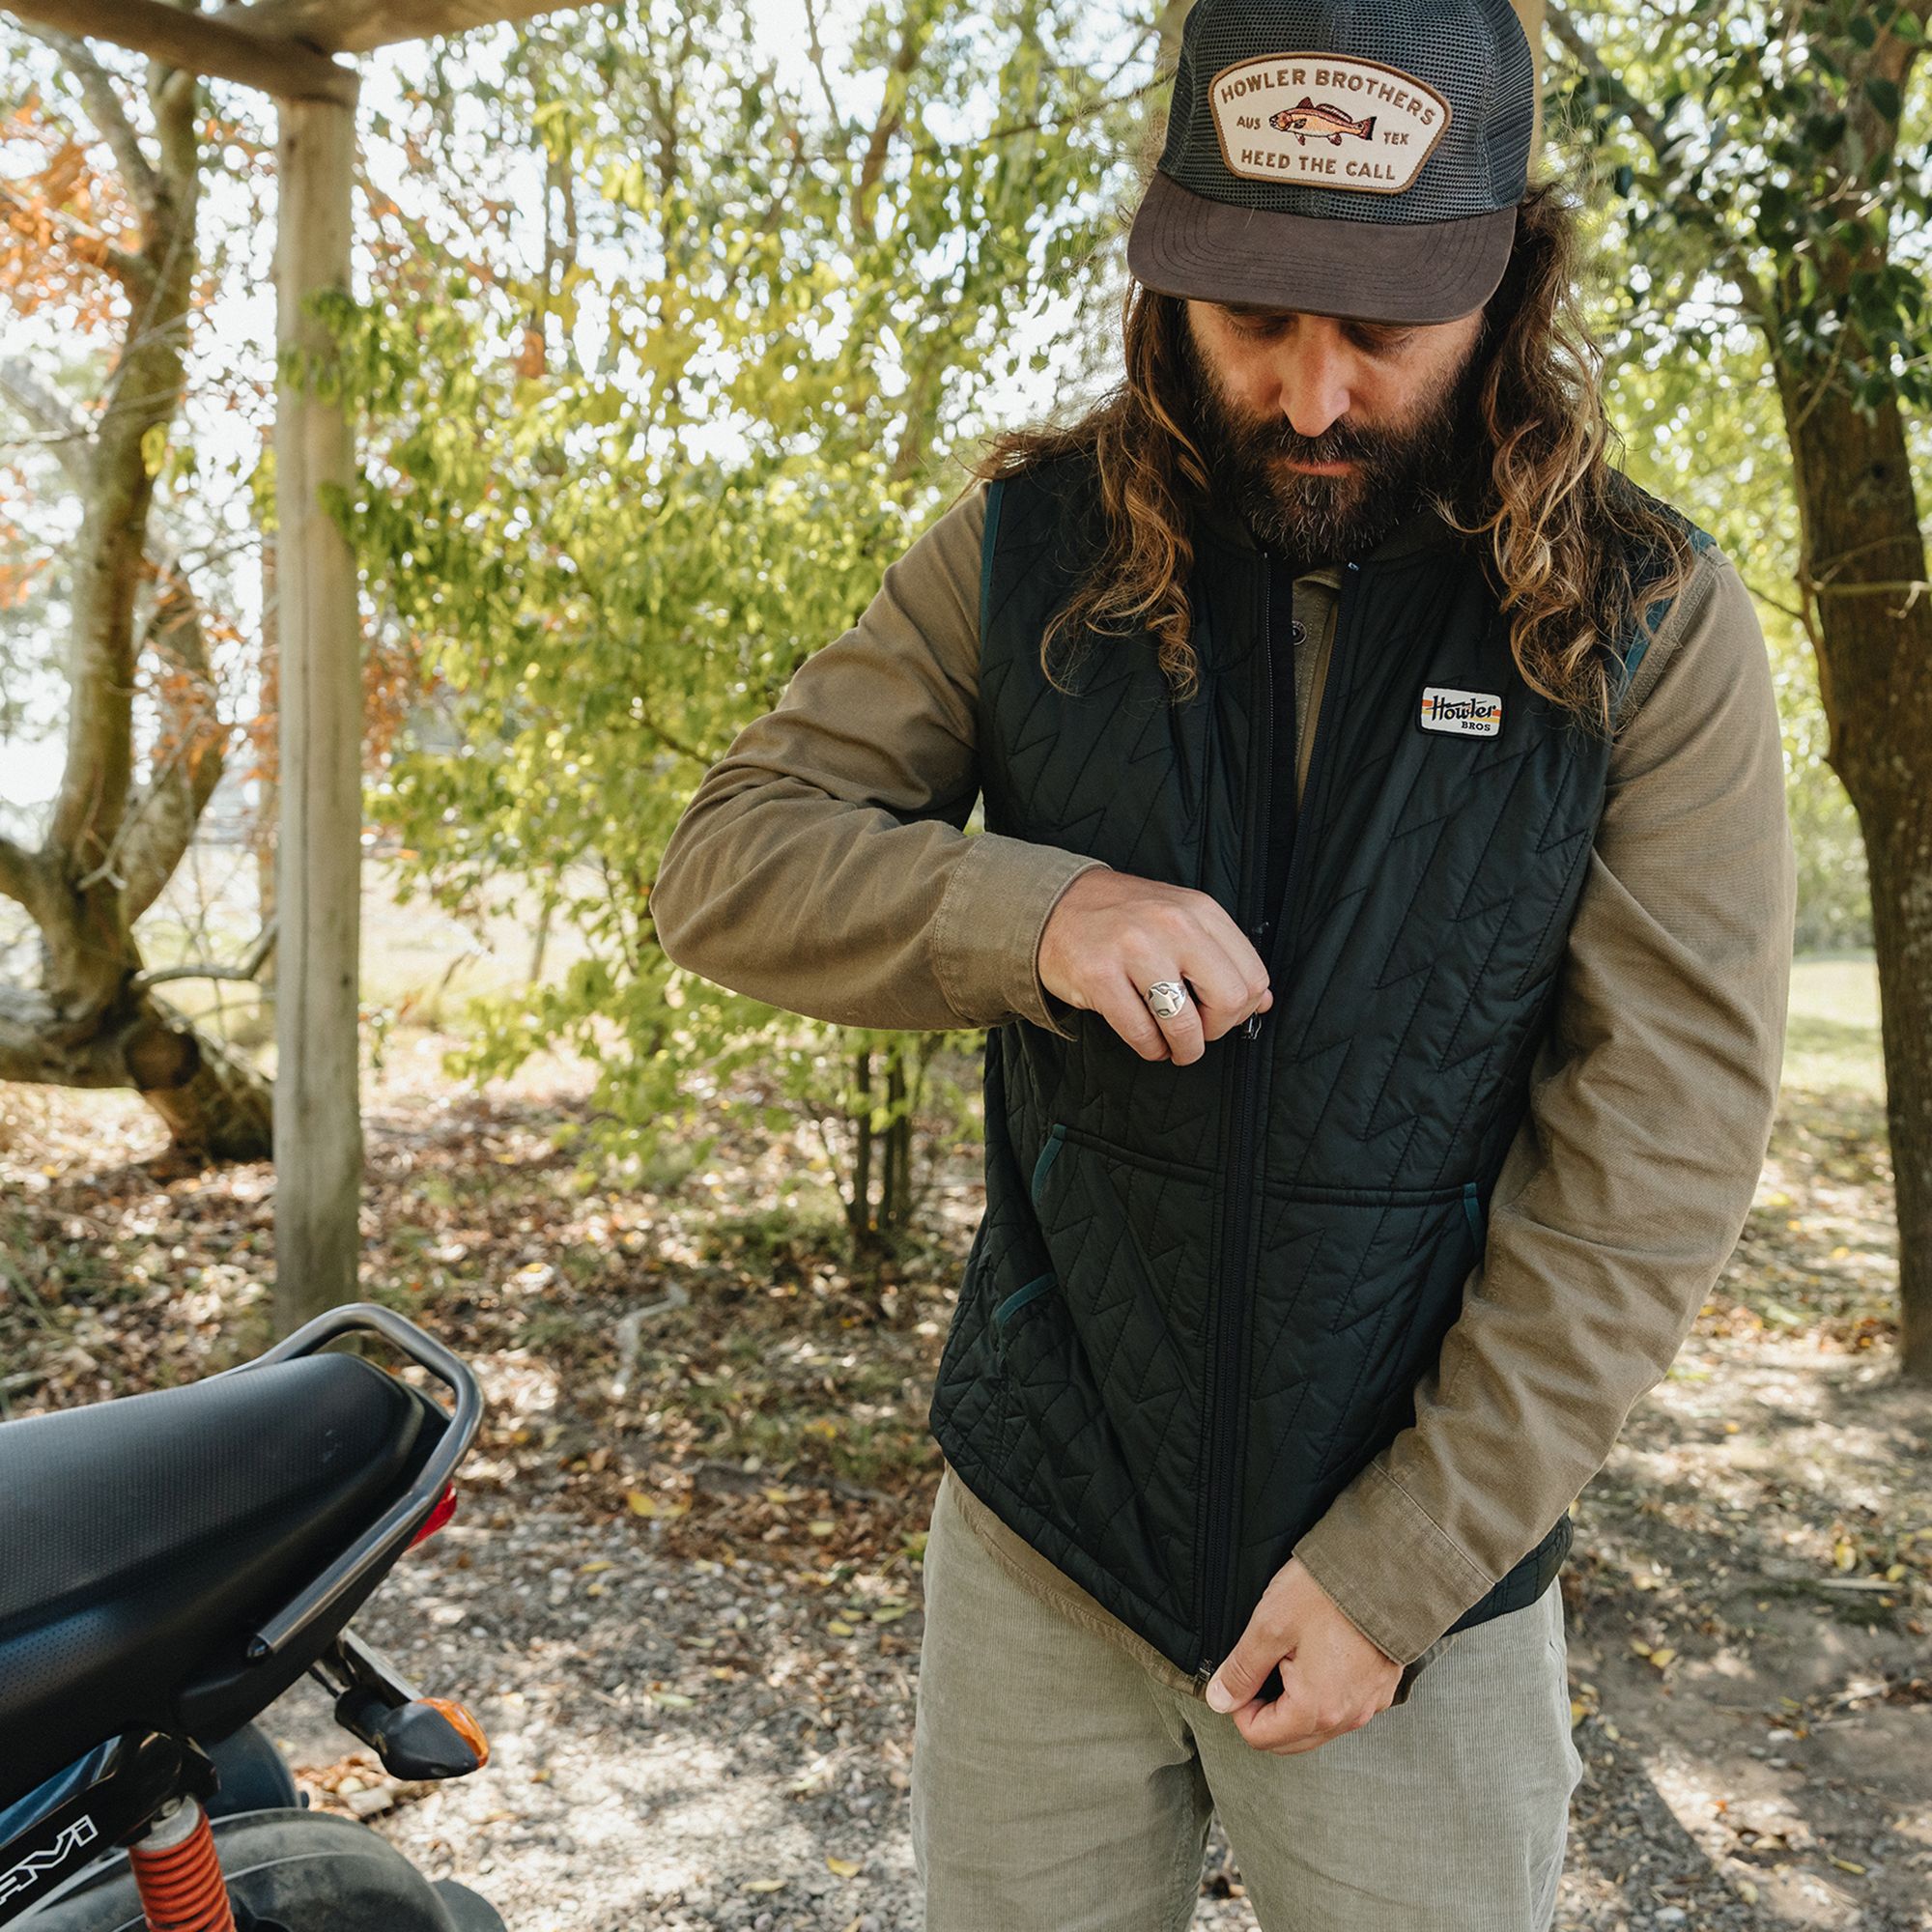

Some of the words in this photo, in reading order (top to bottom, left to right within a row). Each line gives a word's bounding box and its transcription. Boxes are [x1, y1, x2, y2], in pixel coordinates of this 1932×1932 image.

[1221, 69, 1307, 104] HOWLER
[1315, 69, 1436, 126] BROTHERS
[1236, 116, 1261, 130] AUS
[1383, 131, 1409, 145] TEX
[1241, 149, 1292, 169] HEED
[1298, 156, 1337, 175] THE
[1346, 161, 1396, 181] CALL
[1425, 696, 1496, 721] Howler
[1461, 721, 1491, 731] BROS
